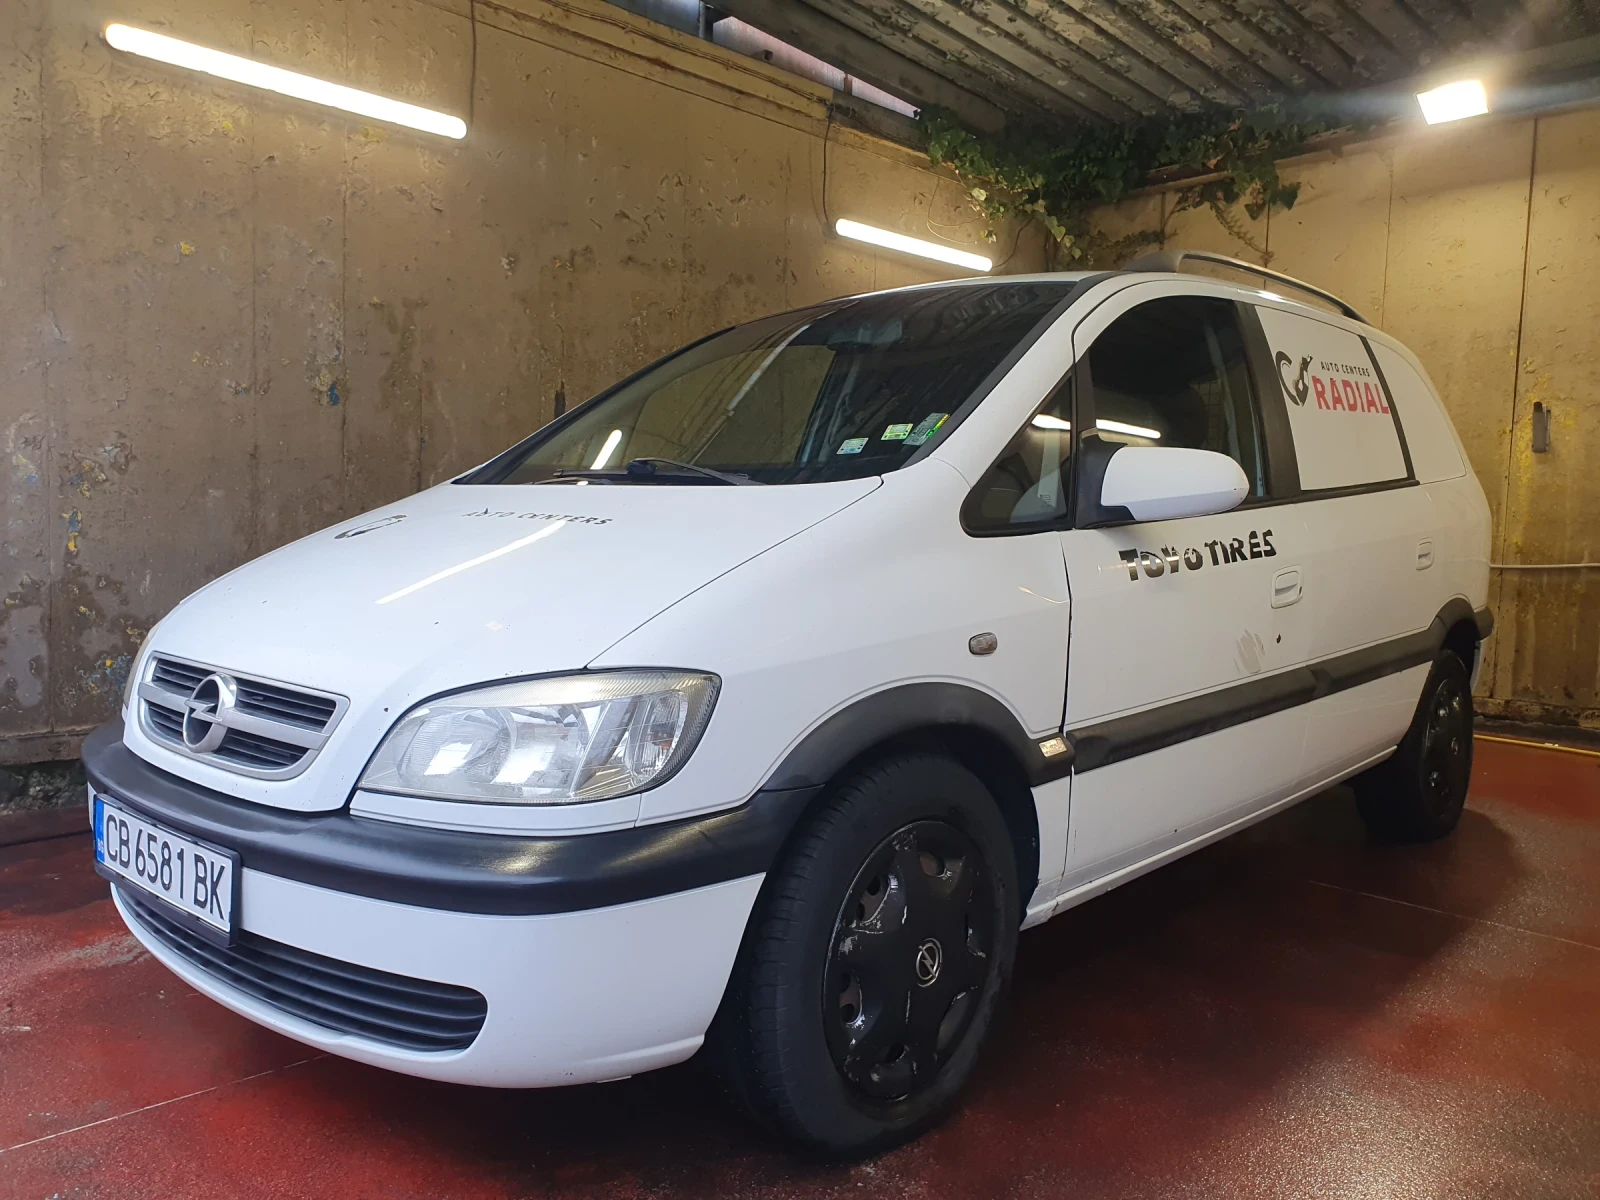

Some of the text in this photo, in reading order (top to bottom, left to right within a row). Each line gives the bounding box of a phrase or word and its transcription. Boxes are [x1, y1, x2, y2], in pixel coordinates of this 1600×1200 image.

[1320, 361, 1371, 377] AUTO CENTERS
[1311, 375, 1390, 415] RADIAL
[517, 512, 613, 525] CENTERS
[1118, 530, 1277, 581] TOYO TIRES
